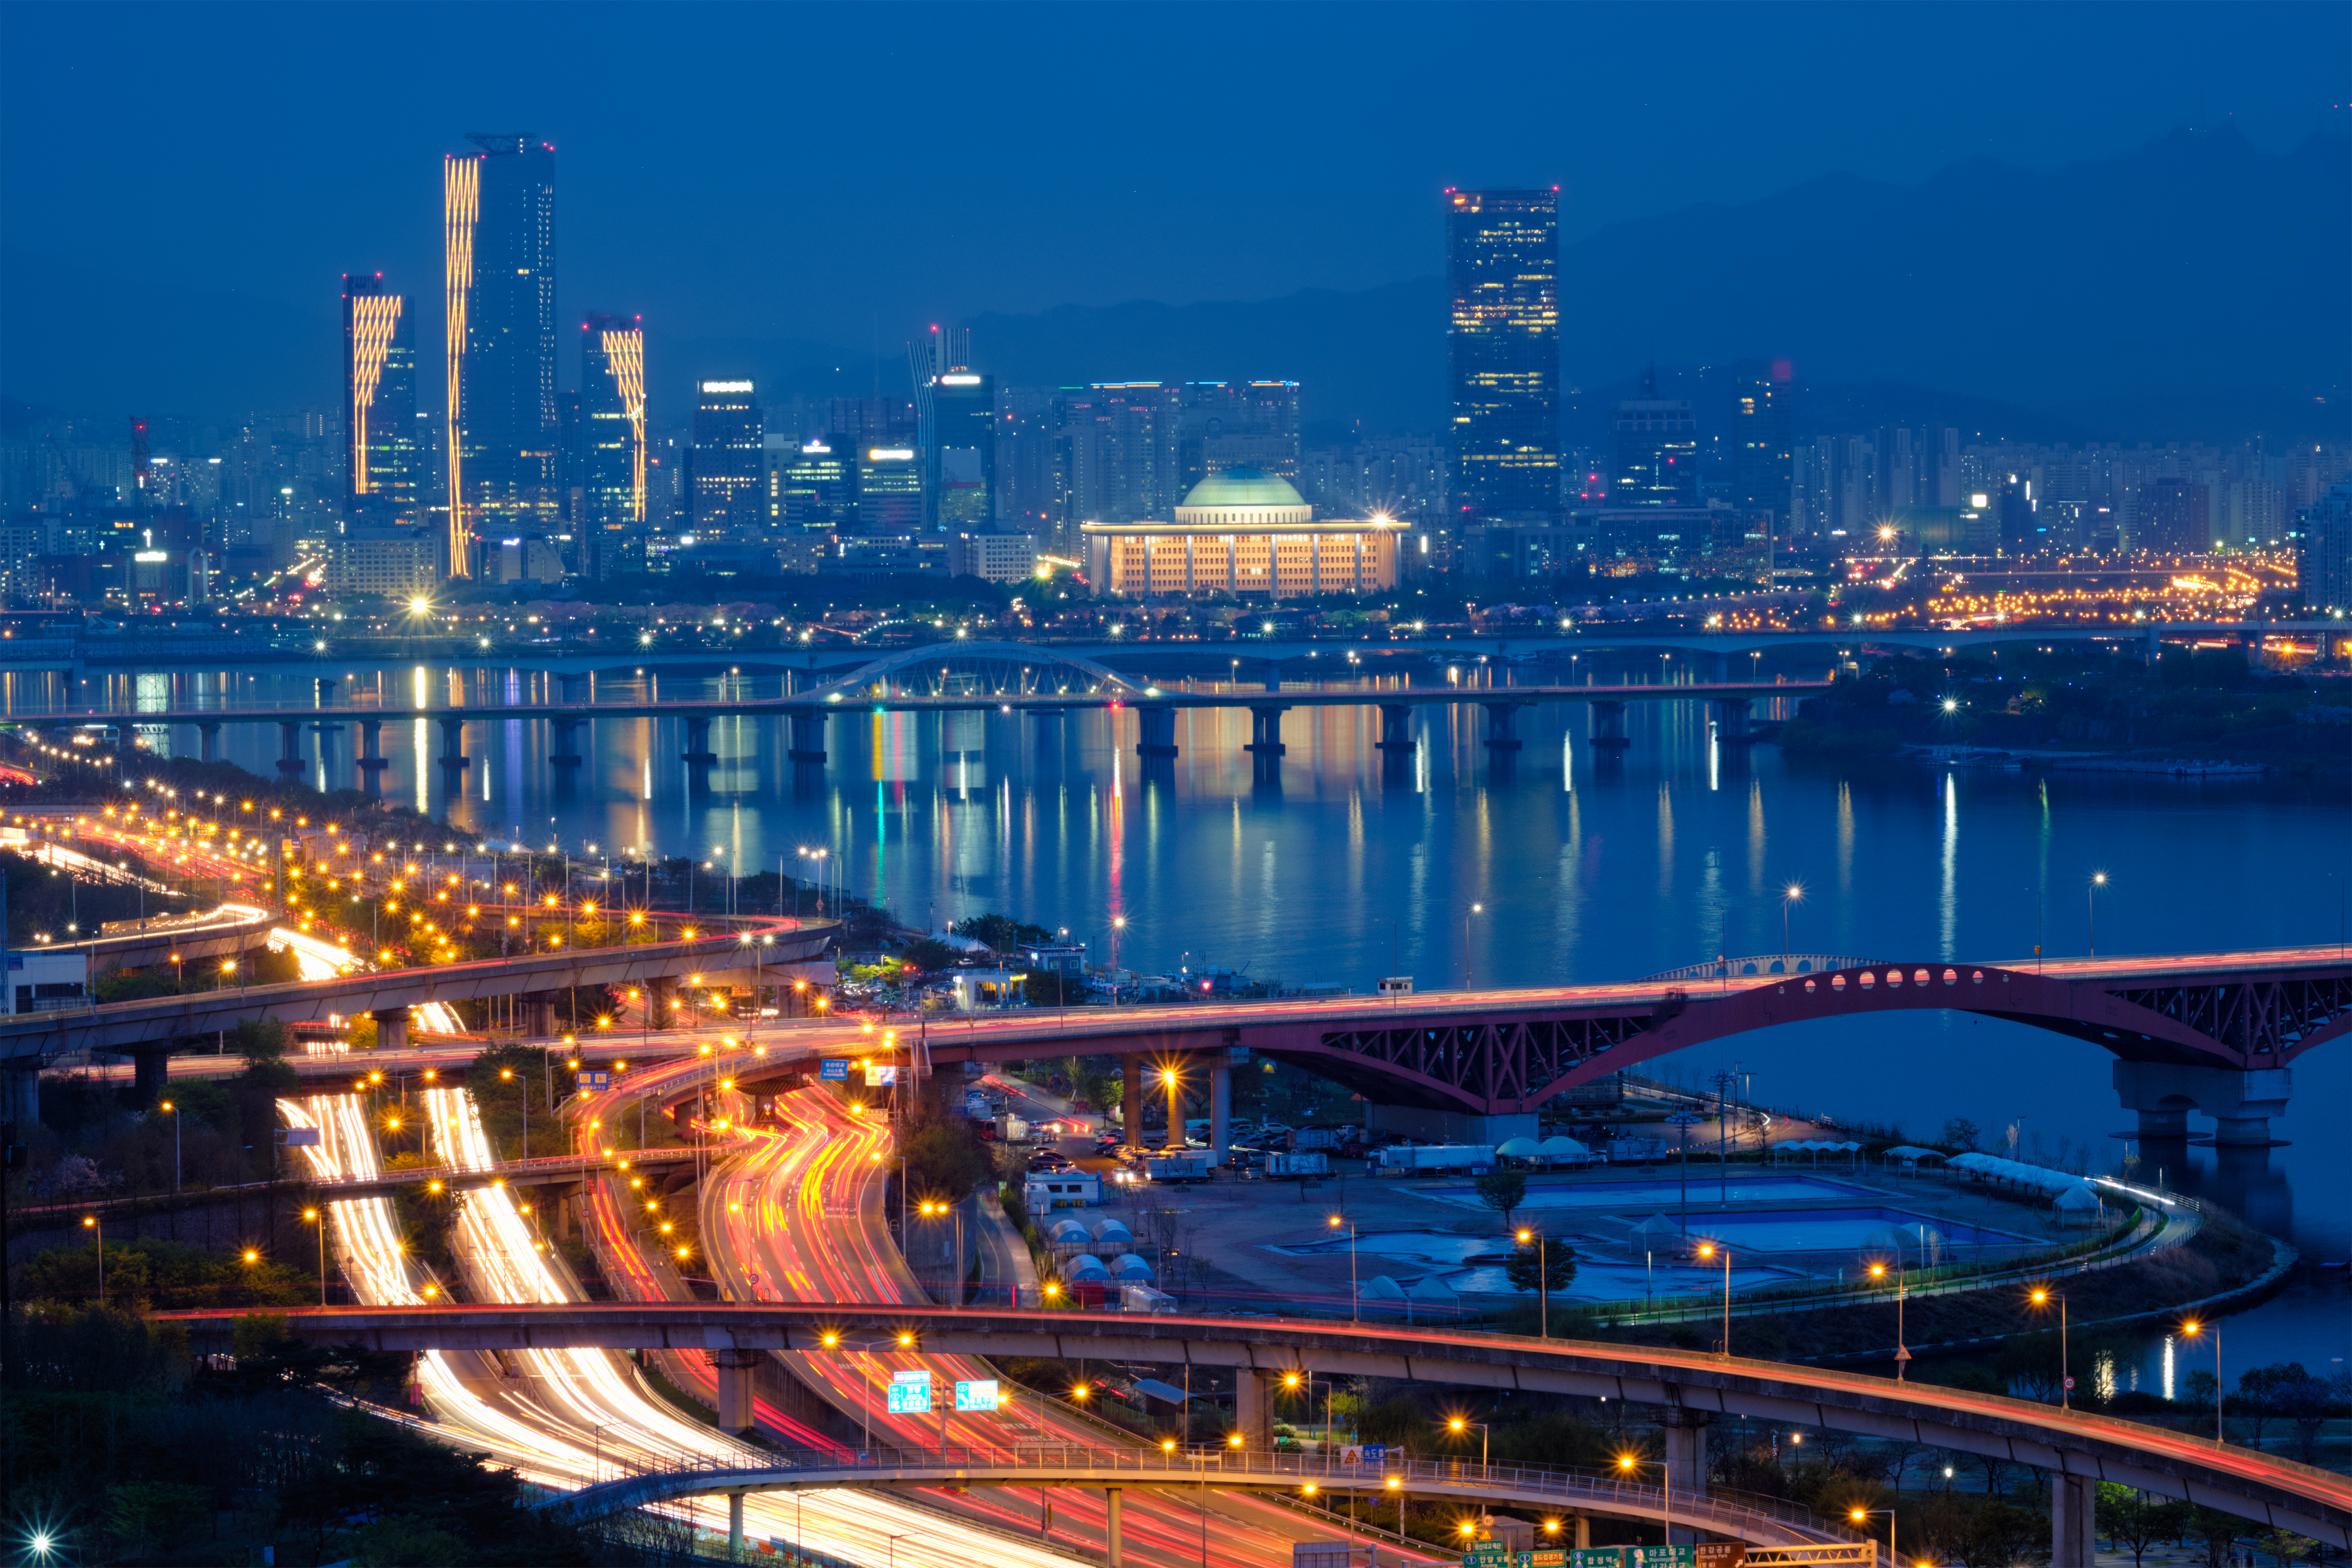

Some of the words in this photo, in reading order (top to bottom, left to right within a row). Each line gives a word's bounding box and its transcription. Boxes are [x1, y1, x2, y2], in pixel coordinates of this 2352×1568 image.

[1365, 1448, 1384, 1458] 속도를
[1466, 1543, 1471, 1551] 8
[1700, 1546, 1731, 1554] 한강공원
[1649, 1548, 1685, 1557] 마포대교
[1479, 1556, 1494, 1564] 안양
[1533, 1553, 1563, 1561] 월드컵경기장
[1587, 1556, 1612, 1565] 합정역
